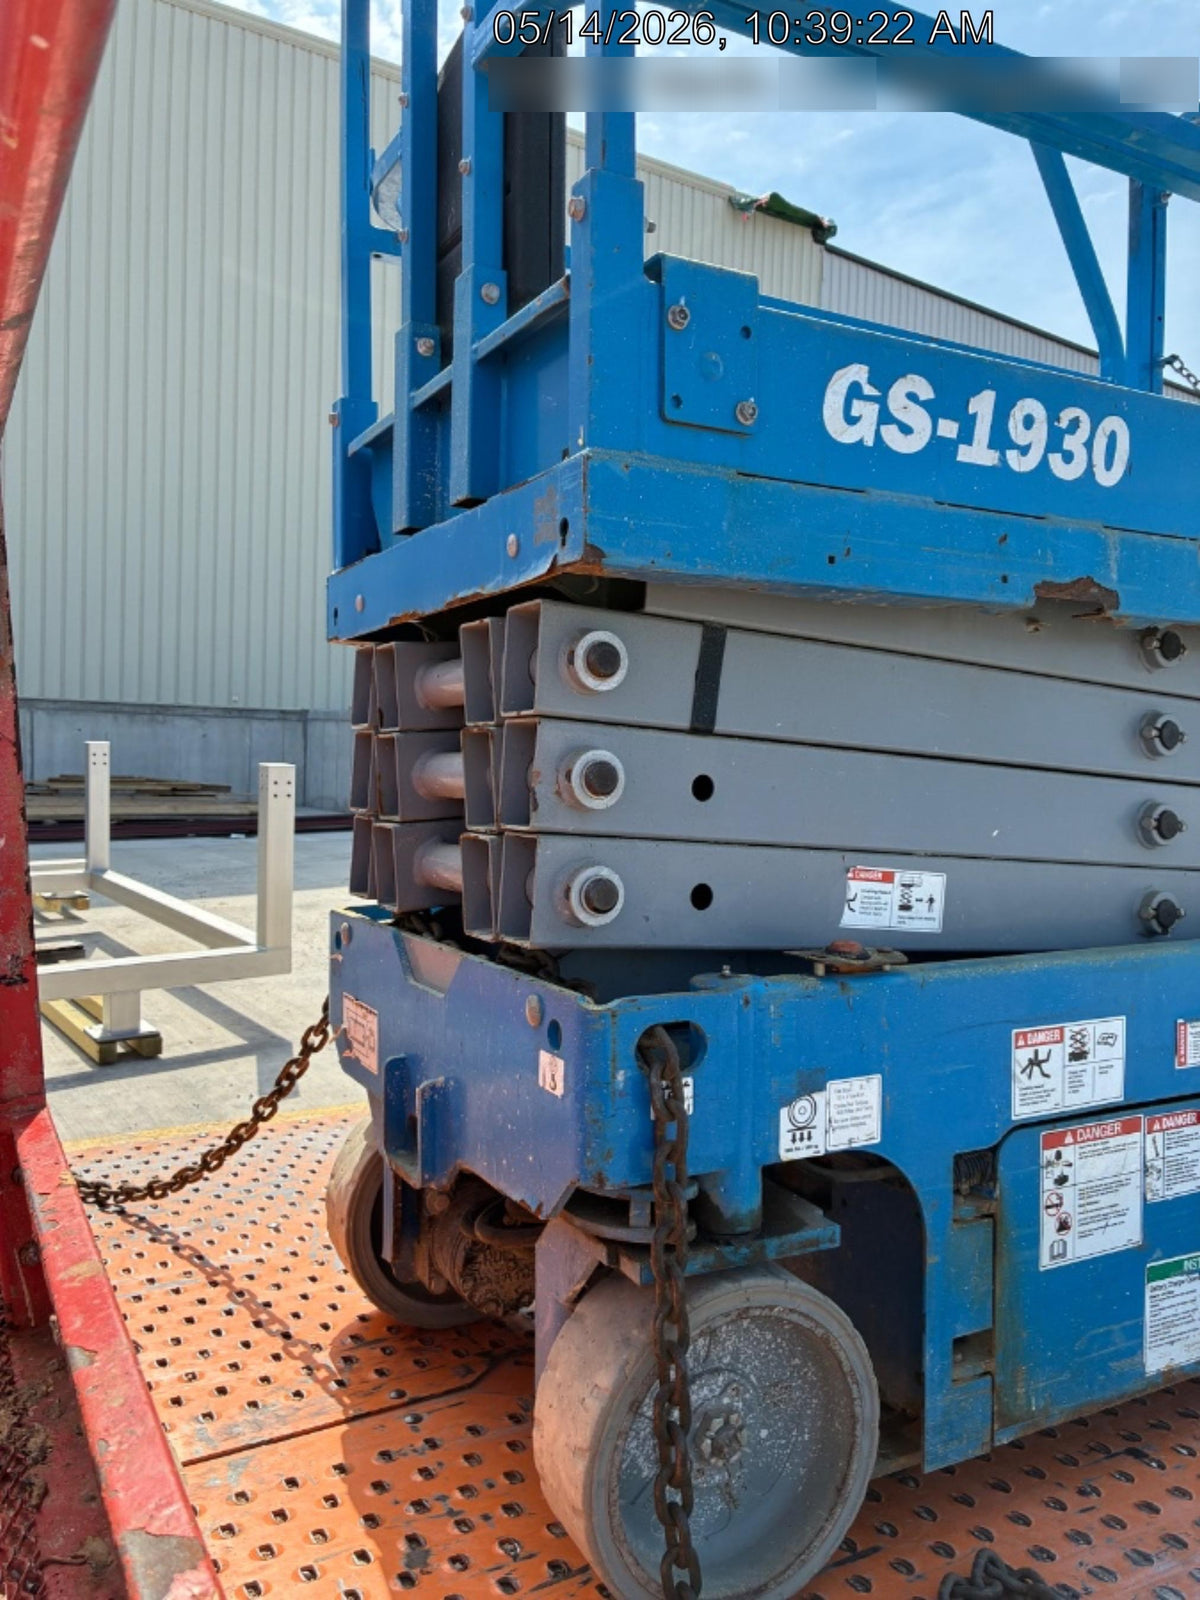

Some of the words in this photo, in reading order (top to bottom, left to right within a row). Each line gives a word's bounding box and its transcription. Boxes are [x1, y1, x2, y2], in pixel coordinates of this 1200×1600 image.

[822, 363, 1131, 488] GS-1930
[1027, 1029, 1061, 1045] DANGER
[1161, 1112, 1197, 1130] DANGER
[1076, 1122, 1122, 1142] DANGER
